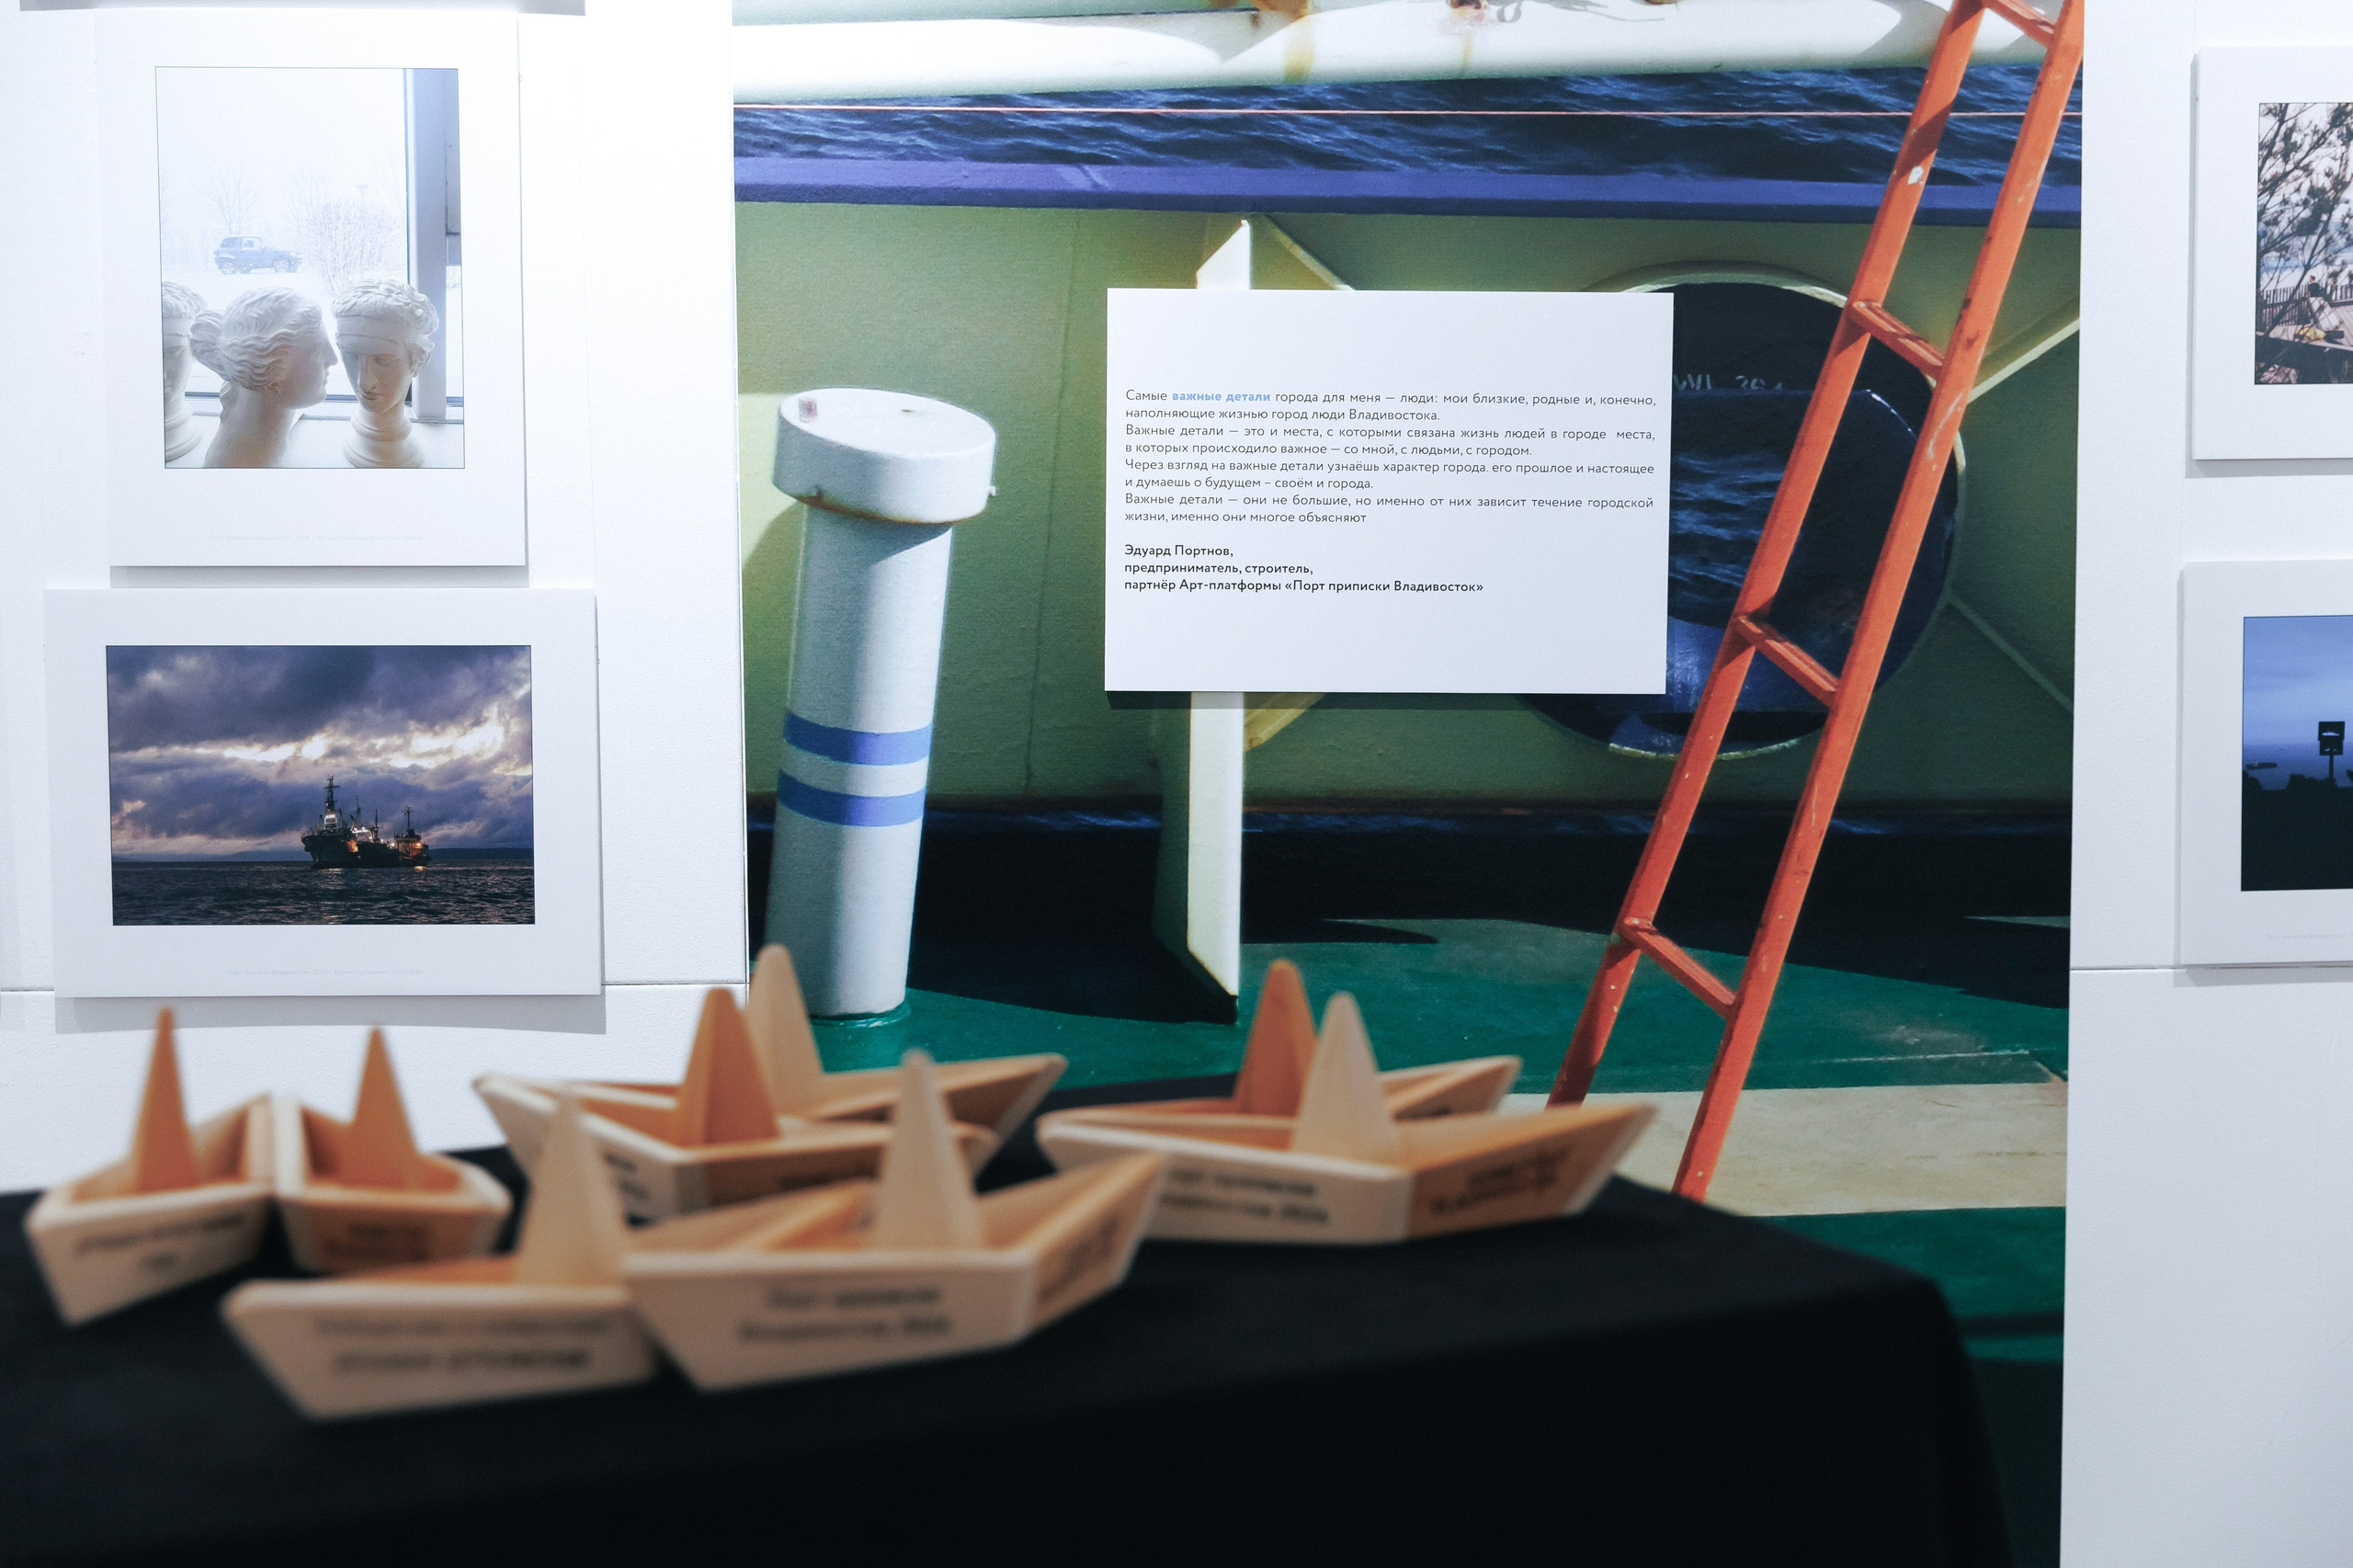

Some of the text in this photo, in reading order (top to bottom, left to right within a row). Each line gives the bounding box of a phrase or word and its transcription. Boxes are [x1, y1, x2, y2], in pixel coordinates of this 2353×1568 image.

[1125, 389, 1168, 402] Самые
[1172, 392, 1222, 402] важные
[1225, 393, 1271, 403] детали
[1275, 393, 1319, 405] города
[1322, 393, 1346, 404] для
[1349, 394, 1381, 403] меня
[1399, 394, 1438, 405] люди:
[1443, 395, 1468, 403] мои
[1472, 392, 1529, 406] близкие,
[1532, 395, 1581, 407] родные
[1585, 396, 1597, 407] и,
[1599, 396, 1656, 407] конечно,
[1125, 408, 1440, 422] наполняющие жизнью город люди Владивостока.
[1126, 423, 1176, 436] Важные
[1179, 427, 1224, 437] детали
[1244, 427, 1266, 437] это
[1269, 428, 1278, 437] и
[1283, 428, 1323, 439] места,
[1326, 428, 1335, 437] с
[1338, 428, 1402, 440] которыми
[1406, 429, 1456, 438] связана
[1460, 429, 1500, 438] жизнь
[1504, 427, 1546, 440] людей
[1551, 430, 1558, 439] в
[1563, 430, 1607, 442] городе
[1616, 431, 1655, 442] места,
[1125, 444, 1132, 453] в
[1135, 444, 1189, 456] которых
[1192, 444, 1278, 456] происходило
[1280, 445, 1327, 454] важное
[1343, 446, 1359, 455] со
[1361, 443, 1398, 457] мной,
[1400, 446, 1408, 455] с
[1410, 447, 1463, 458] людьми,
[1465, 447, 1473, 456] с
[1475, 447, 1532, 459] городом.
[1125, 458, 1165, 472] Через
[1167, 461, 1209, 472] взгляд
[1211, 461, 1226, 471] на
[1229, 462, 1278, 472] важные
[1279, 462, 1324, 472] детали
[1326, 460, 1380, 474] узнаёшь
[1382, 463, 1440, 475] характер
[1491, 464, 1513, 473] его
[1516, 464, 1573, 476] прошлое
[1575, 465, 1584, 473] и
[1587, 465, 1655, 475] настоящее
[1125, 479, 1133, 487] и
[1135, 478, 1191, 490] думаешь
[1193, 479, 1202, 488] о
[1204, 475, 1261, 491] будущем
[1274, 477, 1313, 489] своём
[1316, 480, 1324, 488] и
[1327, 480, 1374, 492] города.
[1125, 492, 1175, 505] Важные
[1178, 495, 1223, 506] детали
[1243, 496, 1267, 506] они
[1272, 496, 1288, 506] не
[1292, 494, 1351, 508] большие,
[1355, 497, 1372, 506] но
[1376, 497, 1426, 506] именно
[1429, 497, 1445, 506] от
[1449, 498, 1472, 506] них
[1476, 498, 1528, 507] зависит
[1530, 498, 1583, 508] течение
[1587, 496, 1654, 511] городской
[1124, 511, 1368, 524] жизни, именно они многое объясняют
[1124, 543, 1233, 559] Эдуард Портнов,
[1124, 564, 1313, 576] предприниматель, строитель,
[1124, 578, 1484, 594] партнёр Арт-платформы «Порт приписки Владивосток»
